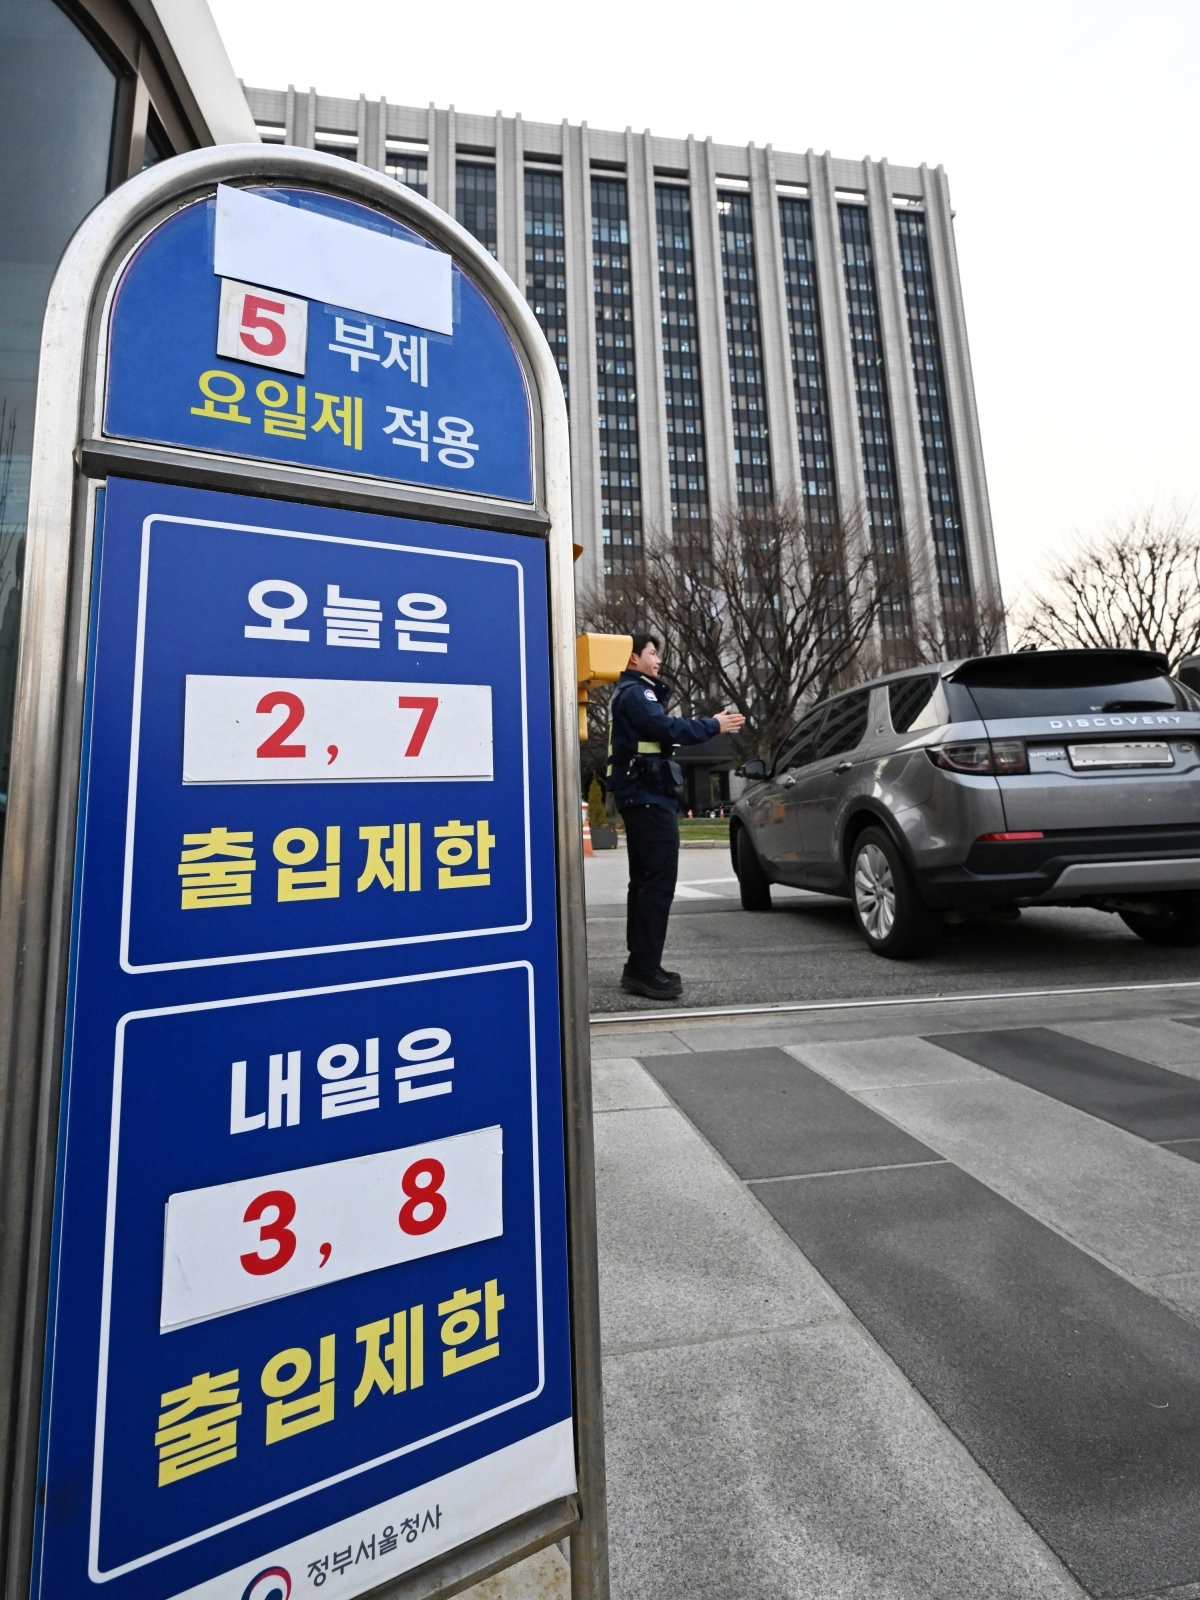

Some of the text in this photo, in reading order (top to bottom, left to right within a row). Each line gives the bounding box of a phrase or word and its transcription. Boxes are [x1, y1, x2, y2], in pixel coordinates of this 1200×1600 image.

[239, 293, 429, 388] 5 부제
[190, 369, 480, 470] 요일제 적용
[244, 579, 450, 653] 오늘은
[398, 696, 439, 757] 7
[1029, 750, 1066, 758] SPORT
[1049, 716, 1181, 729] DISCOVERY
[177, 820, 496, 910] 출입제한
[229, 1027, 455, 1135] 내일은
[398, 1157, 447, 1236] 8
[154, 1278, 505, 1488] 출입제한
[307, 1503, 442, 1587] 정부서울청사
